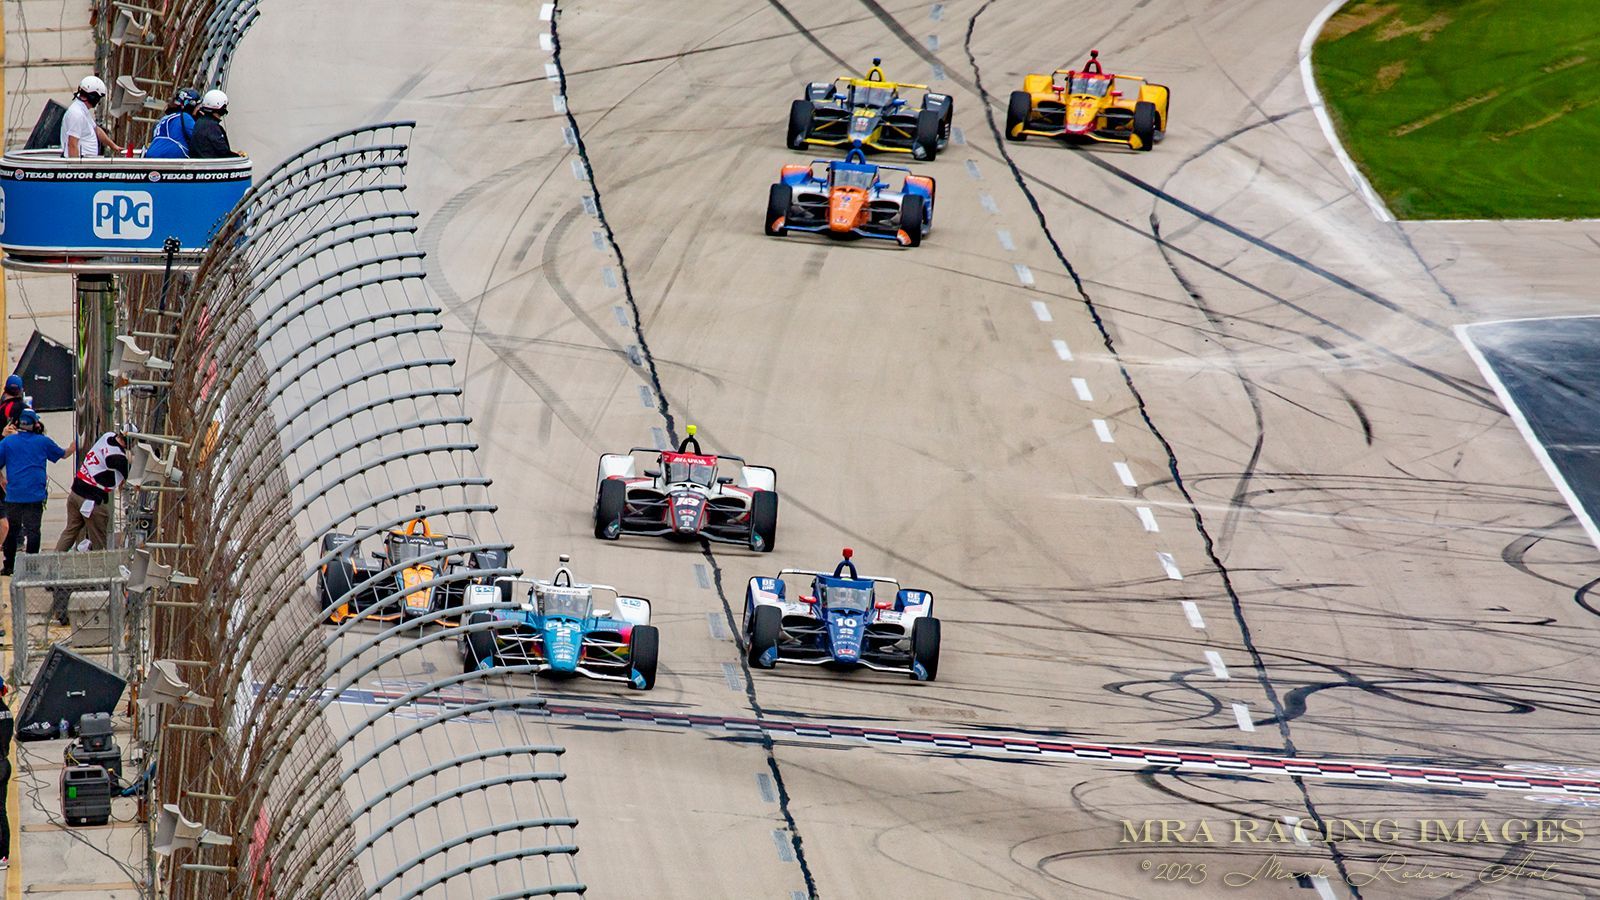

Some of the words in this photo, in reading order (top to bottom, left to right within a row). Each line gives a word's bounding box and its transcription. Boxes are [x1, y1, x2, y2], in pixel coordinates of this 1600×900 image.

[196, 172, 229, 180] MOTOR
[96, 195, 150, 234] PPG
[836, 618, 857, 628] 10
